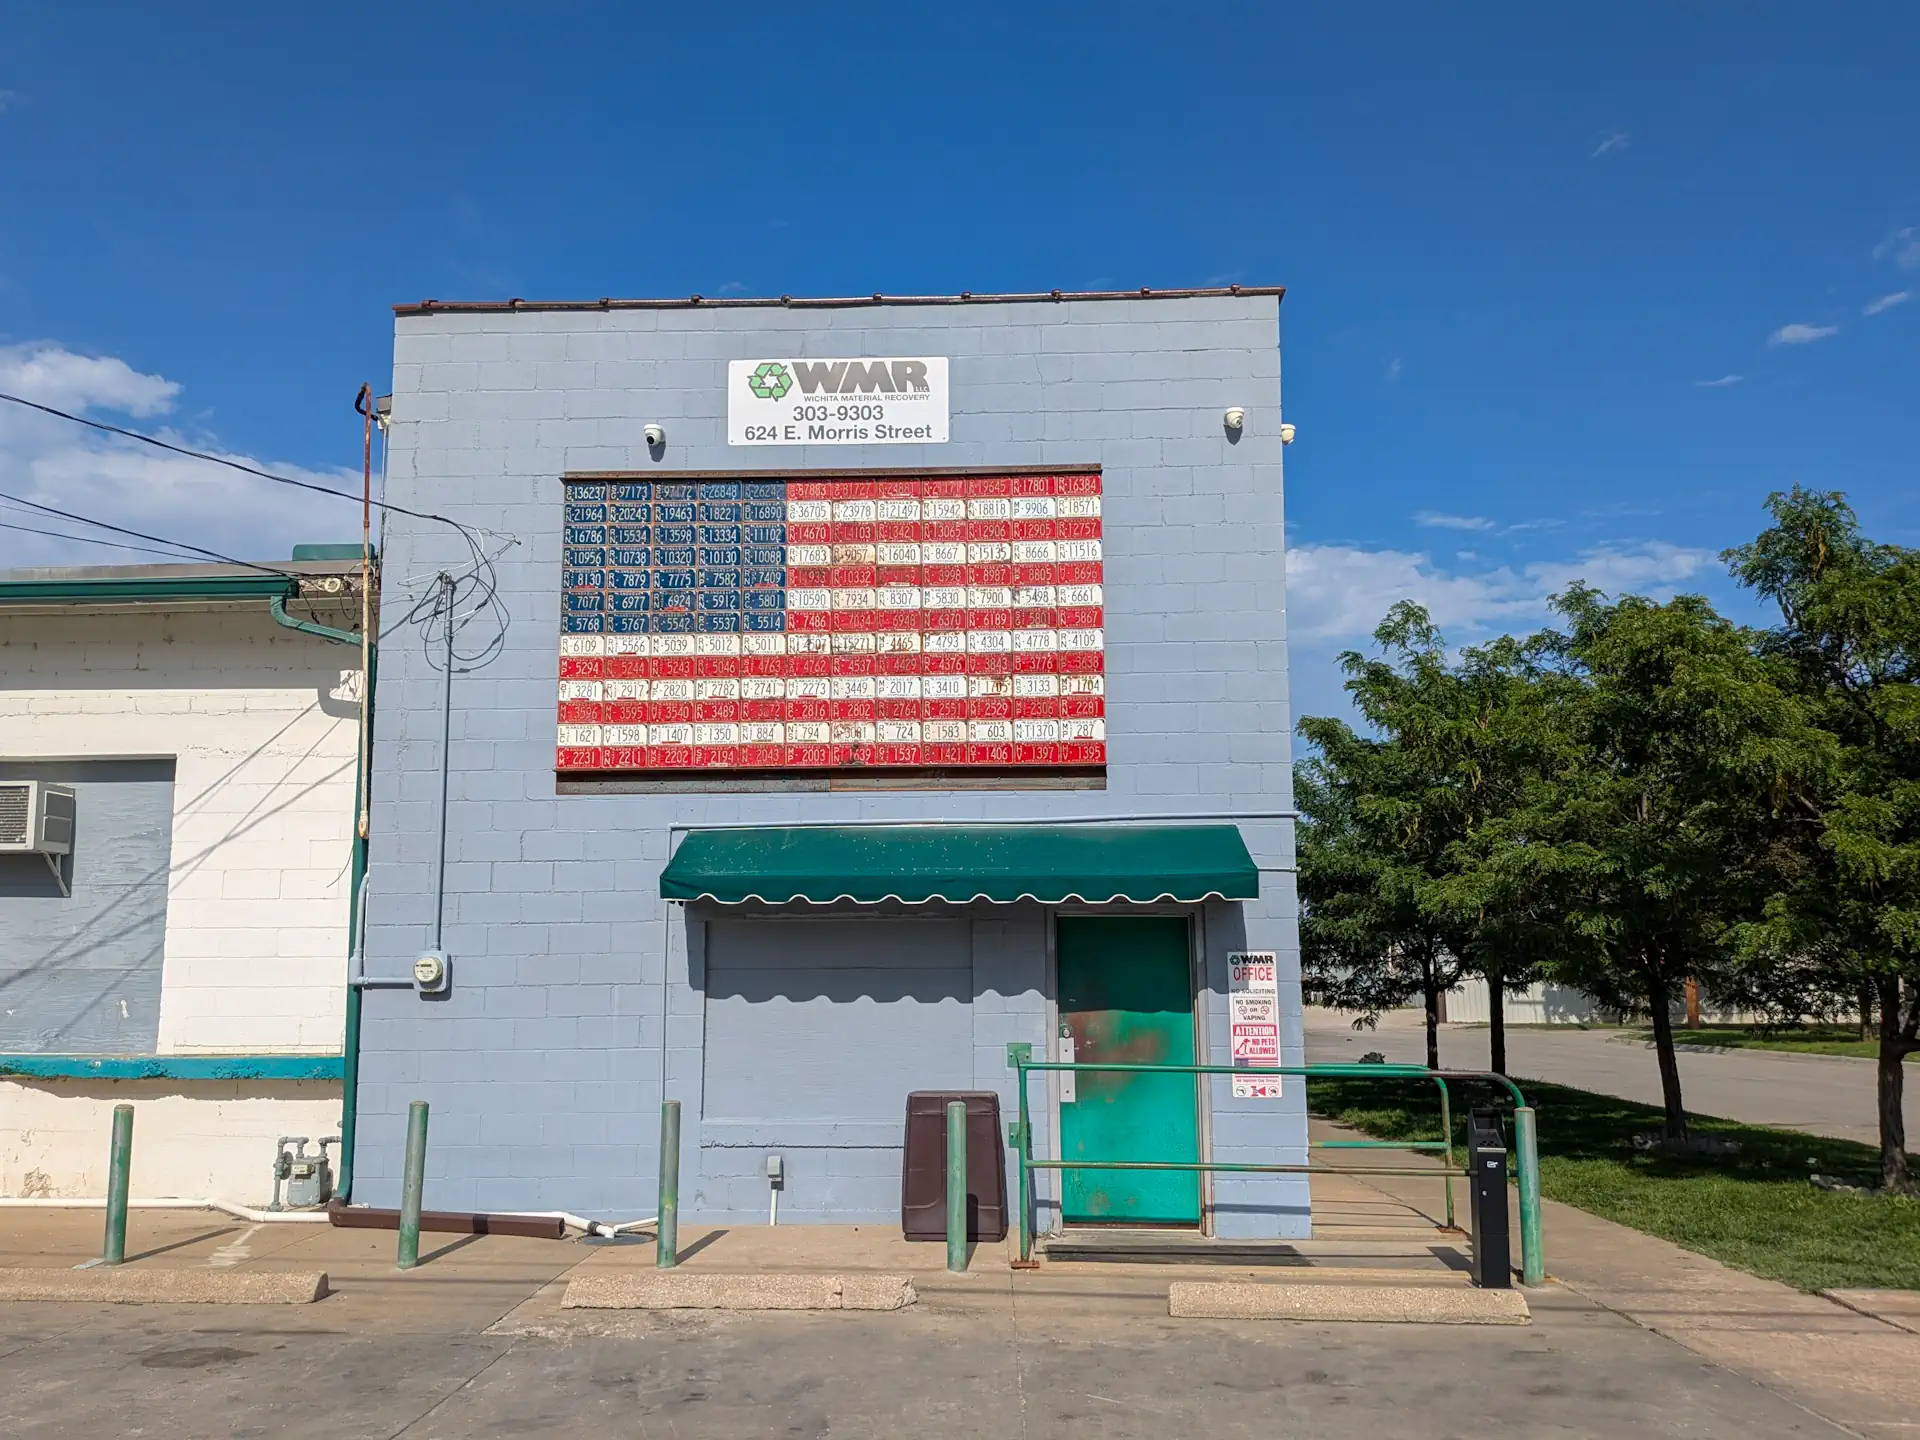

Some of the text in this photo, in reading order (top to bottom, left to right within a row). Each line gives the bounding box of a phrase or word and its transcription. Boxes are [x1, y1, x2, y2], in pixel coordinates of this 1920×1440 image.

[792, 361, 930, 393] WMR
[793, 405, 884, 421] 303-9303
[745, 424, 931, 440] 624 E. Morris Street
[1023, 479, 1049, 491] 17801
[1069, 479, 1095, 491] 16384
[574, 486, 605, 499] 136237
[620, 486, 647, 499] 97173
[709, 486, 736, 498] 26848
[574, 508, 602, 520] 21964
[619, 508, 647, 520] 20243
[665, 508, 692, 520] 19463
[710, 508, 735, 520] 18221
[800, 506, 826, 517] 36705
[843, 506, 871, 517] 23978
[979, 503, 1005, 515] 18818
[1026, 503, 1048, 514] 9906
[1069, 502, 1095, 514] 18571
[800, 527, 826, 538] 14670
[1023, 524, 1051, 536] 12905
[1069, 522, 1096, 535] 12757
[575, 530, 602, 542] 16786
[620, 530, 646, 542] 15534
[665, 530, 691, 542] 13598
[709, 529, 736, 541] 13334
[755, 529, 781, 541] 11102
[755, 551, 781, 563] 10088
[800, 550, 826, 561] 17683
[936, 549, 957, 560] 8667
[1026, 547, 1048, 558] 8666
[1069, 545, 1097, 557] 11516
[575, 552, 601, 564] 10956
[620, 552, 646, 564] 10738
[665, 552, 691, 563] 10320
[709, 552, 736, 563] 10130
[578, 574, 601, 586] 8130
[623, 574, 645, 586] 7879
[669, 574, 691, 586] 7775
[714, 573, 736, 586] 7582
[760, 572, 781, 583] 7409
[843, 571, 871, 583] 10332
[577, 597, 600, 608] 7077
[622, 597, 645, 608] 6977
[668, 596, 690, 607] 6924
[713, 595, 735, 608] 5912
[800, 594, 825, 605] 10590
[846, 594, 868, 605] 7934
[891, 593, 912, 604] 8307
[936, 593, 958, 604] 5830
[668, 618, 690, 630] 5542
[713, 618, 736, 630] 5537
[758, 617, 780, 629] 5514
[804, 616, 825, 627] 7486
[984, 613, 1006, 625] 6189
[1075, 612, 1097, 624] 5867
[576, 619, 599, 630] 5768
[622, 619, 645, 630] 5767
[574, 640, 596, 652] 6109
[623, 640, 645, 652] 5566
[665, 640, 687, 652] 5039
[710, 640, 732, 651] 5012
[756, 639, 776, 650] 5011
[936, 636, 958, 647] 4793
[981, 636, 1003, 648] 4304
[1027, 636, 1049, 647] 4778
[1073, 635, 1095, 646] 4109
[576, 662, 598, 674] 5294
[622, 662, 644, 674] 5244
[668, 662, 689, 674] 5243
[760, 661, 780, 673] 4763
[849, 661, 870, 671] 4537
[575, 686, 596, 697] 3281
[622, 685, 644, 696] 2917
[664, 685, 686, 696] 2820
[712, 684, 735, 696] 2782
[755, 684, 776, 694] 2741
[802, 683, 825, 694] 2273
[845, 682, 867, 694] 3449
[891, 682, 912, 693] 2017
[936, 681, 959, 693] 3410
[1028, 681, 1050, 692] 3133
[1077, 680, 1099, 691] 1704
[575, 707, 597, 719] 3596
[620, 707, 643, 718] 3595
[666, 706, 689, 718] 3540
[712, 706, 734, 717] 3489
[802, 705, 825, 716] 2816
[848, 705, 870, 716] 2802
[894, 704, 916, 716] 2764
[985, 703, 1008, 716] 2529
[1077, 702, 1098, 714] 2281
[575, 730, 595, 742] 1621
[617, 729, 639, 741] 1598
[667, 729, 688, 740] 1407
[710, 728, 731, 739] 1350
[757, 728, 774, 739] 884
[803, 728, 819, 739] 794
[896, 726, 913, 738] 724
[938, 726, 959, 737] 1583
[988, 726, 1005, 737] 603
[1077, 724, 1094, 736] 287
[573, 752, 594, 764] 2231
[895, 748, 916, 761] 1537
[941, 747, 960, 760] 1421
[986, 747, 1007, 759] 1406
[1032, 747, 1054, 759] 1397
[1078, 746, 1100, 759] 1395
[1240, 956, 1274, 964] WMR
[1234, 967, 1272, 980] OFFICE
[1236, 1026, 1273, 1036] ATTENTION
